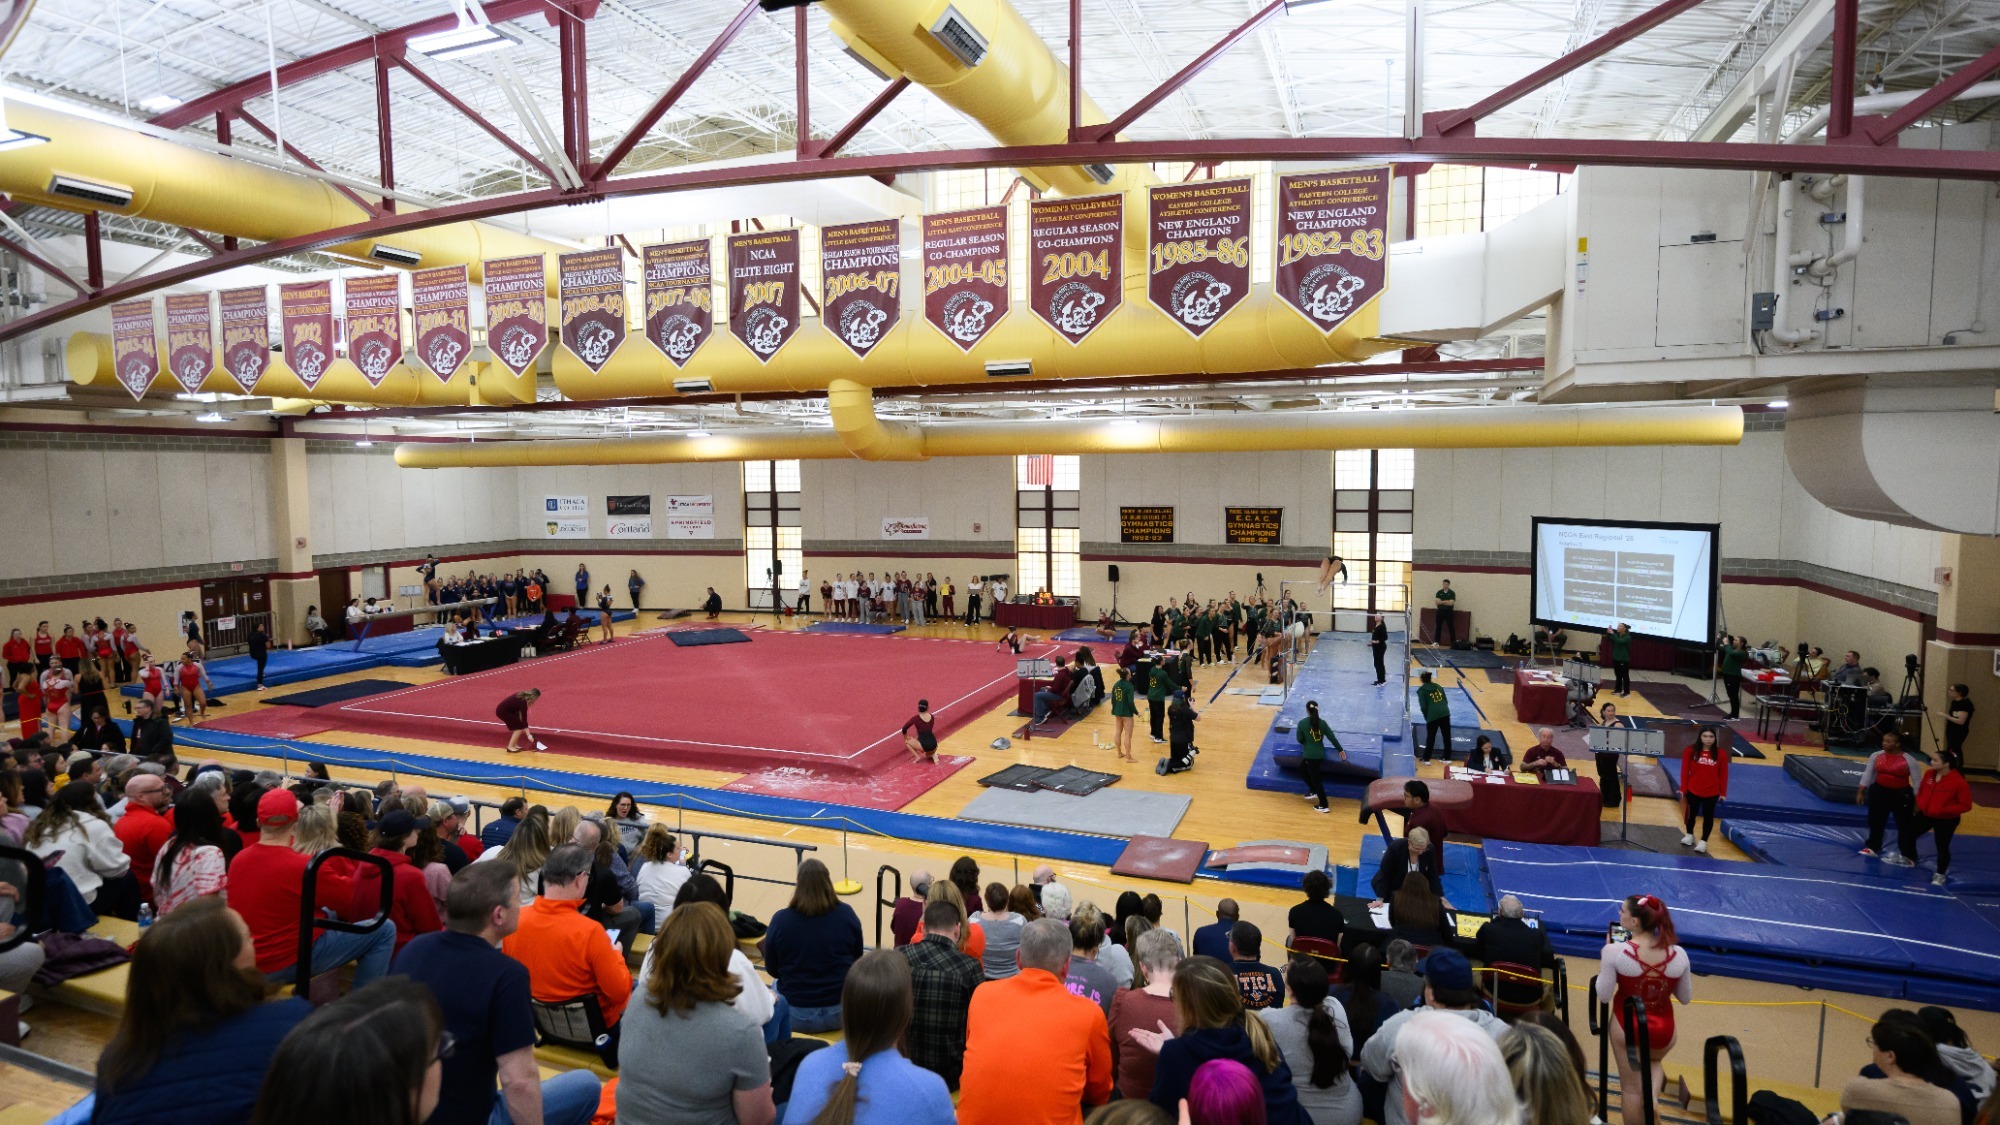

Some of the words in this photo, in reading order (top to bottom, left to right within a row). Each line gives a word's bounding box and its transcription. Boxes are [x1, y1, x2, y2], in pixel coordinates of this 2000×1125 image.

[1289, 180, 1318, 189] MEN'S
[1320, 175, 1379, 186] BASKETBALL
[1152, 191, 1192, 201] WOMEN'S
[1194, 185, 1249, 197] BASKETBALL
[1333, 188, 1368, 196] COLLEGE
[1032, 204, 1068, 214] WOMEN'S
[1070, 200, 1121, 210] VOLLEYBALL
[1200, 198, 1232, 206] COLLEGE
[1289, 199, 1325, 207] ATHLETIC
[1327, 195, 1378, 204] CONFERENCE
[1074, 210, 1117, 219] CONFERENCE
[1159, 209, 1193, 217] ATHLETIC
[1194, 204, 1241, 214] CONFERENCE
[1287, 210, 1315, 221] NEW
[1317, 206, 1376, 218] ENGLAND
[930, 218, 953, 227] MEN'S
[954, 212, 999, 224] BASKETBALL
[963, 222, 1003, 231] CONFERENCE
[1158, 220, 1183, 230] NEW
[1186, 215, 1240, 228] ENGLAND
[1296, 217, 1367, 230] CHAMPIONS
[850, 225, 891, 235] BASKETBALL
[1033, 226, 1078, 237] REGULAR
[1080, 222, 1119, 233] SEASON
[1166, 226, 1232, 239] CHAMPIONS
[754, 235, 792, 245] BASKETBALL
[925, 237, 967, 249] REGULAR
[969, 233, 1004, 244] SEASON
[1037, 235, 1114, 249] CO-CHAMPIONS
[750, 248, 776, 260] NCAA
[930, 245, 1000, 260] CO-CHAMPIONS
[1279, 228, 1384, 267] 1982-83
[824, 253, 899, 271] CHAMPIONS
[1151, 236, 1248, 274] 1985-86
[646, 264, 710, 280] CHAMPIONS
[654, 260, 700, 270] TOURNAMENT
[734, 266, 761, 278] ELITE
[763, 262, 794, 275] EIGHT
[1042, 249, 1111, 285] 2004
[562, 272, 622, 287] CHAMPIONS
[666, 277, 709, 286] TOURNAMENT
[925, 258, 1007, 296] 2004-05
[486, 279, 544, 293] CHAMPIONS
[825, 270, 899, 306] 2006-07
[299, 288, 330, 299] BASKETBALL
[414, 289, 467, 303] CHAMPIONS
[744, 281, 784, 312] 2007
[346, 296, 398, 308] CHAMPIONS
[646, 288, 712, 320] 2007-08
[223, 308, 266, 320] CHAMPIONS
[350, 316, 398, 343] 2011-12
[418, 310, 467, 339] 2010-11
[293, 322, 322, 346] 2012
[166, 662, 174, 672] 4
